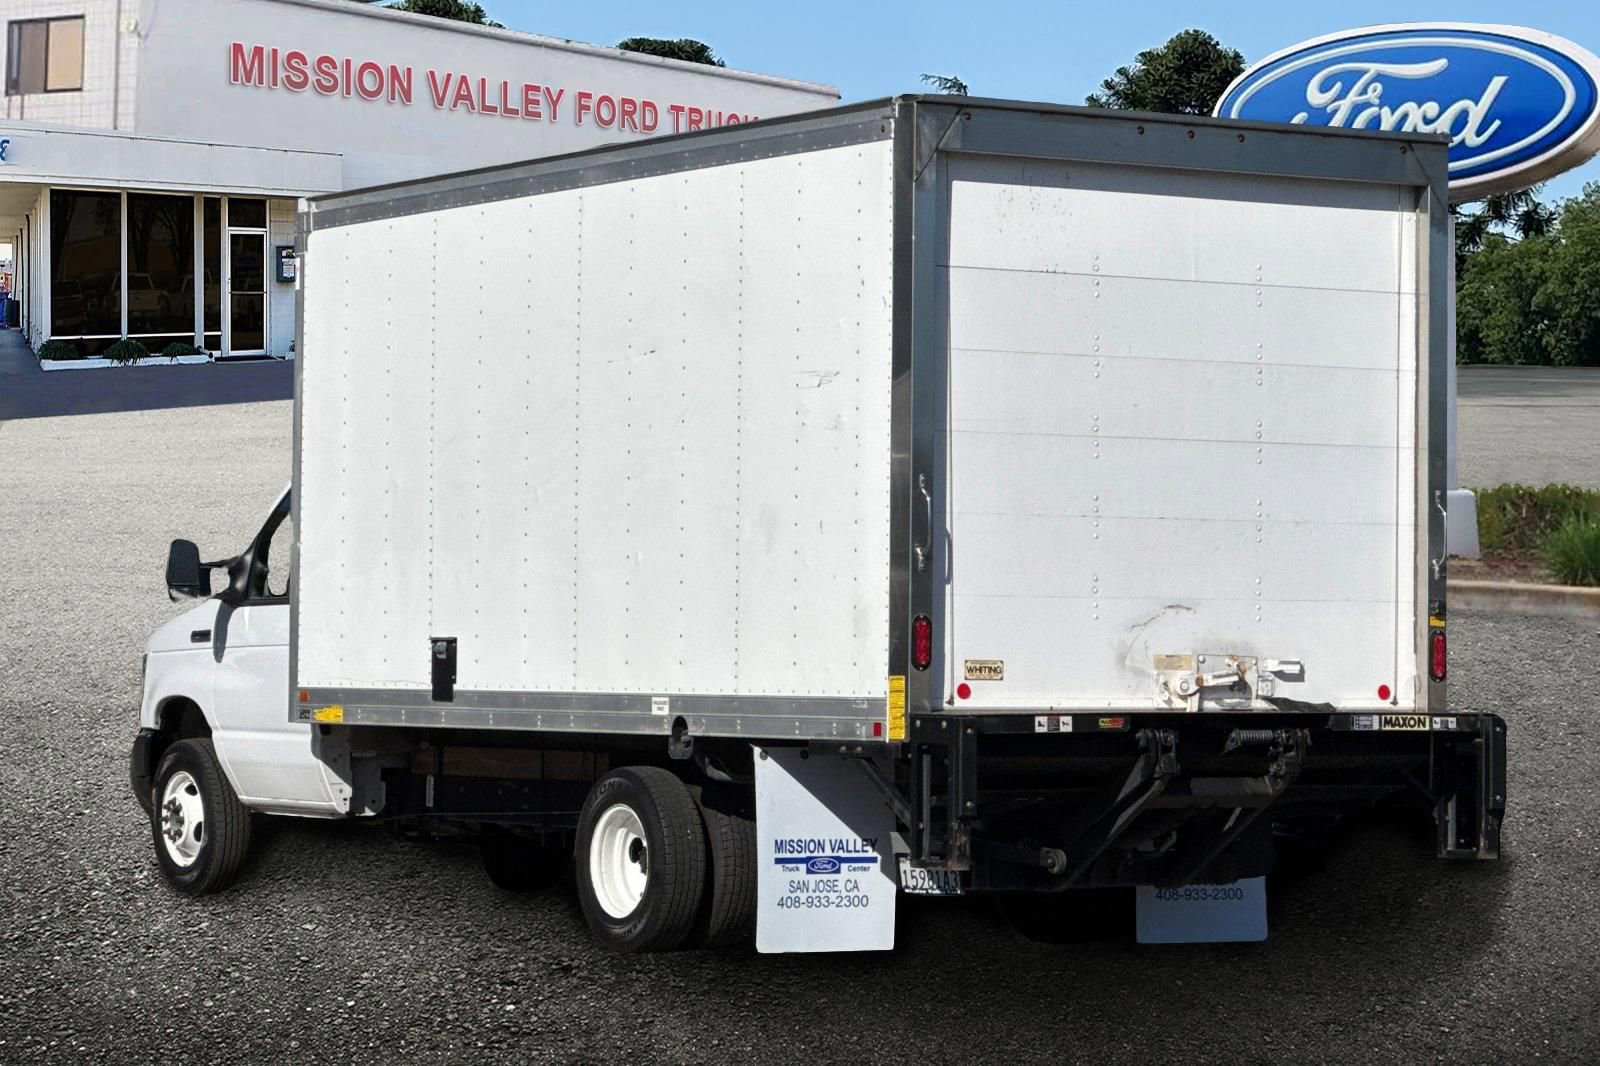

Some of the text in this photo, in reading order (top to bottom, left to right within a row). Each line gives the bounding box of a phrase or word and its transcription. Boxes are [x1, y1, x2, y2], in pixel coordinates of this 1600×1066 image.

[230, 41, 414, 105] MISSION
[426, 68, 565, 122] VALLEY
[576, 90, 660, 134] FORD
[1291, 58, 1509, 148] Ford
[966, 665, 1002, 674] WHITING
[1383, 716, 1427, 729] MAXON
[774, 838, 878, 854] MISSION VALLEY
[782, 864, 801, 873] Truck
[813, 860, 833, 871] Ford
[847, 864, 871, 873] Center
[788, 879, 860, 894] SAN JOSE, CA
[1155, 888, 1243, 901] 408-933-2300
[777, 894, 869, 909] 408-933-2300
